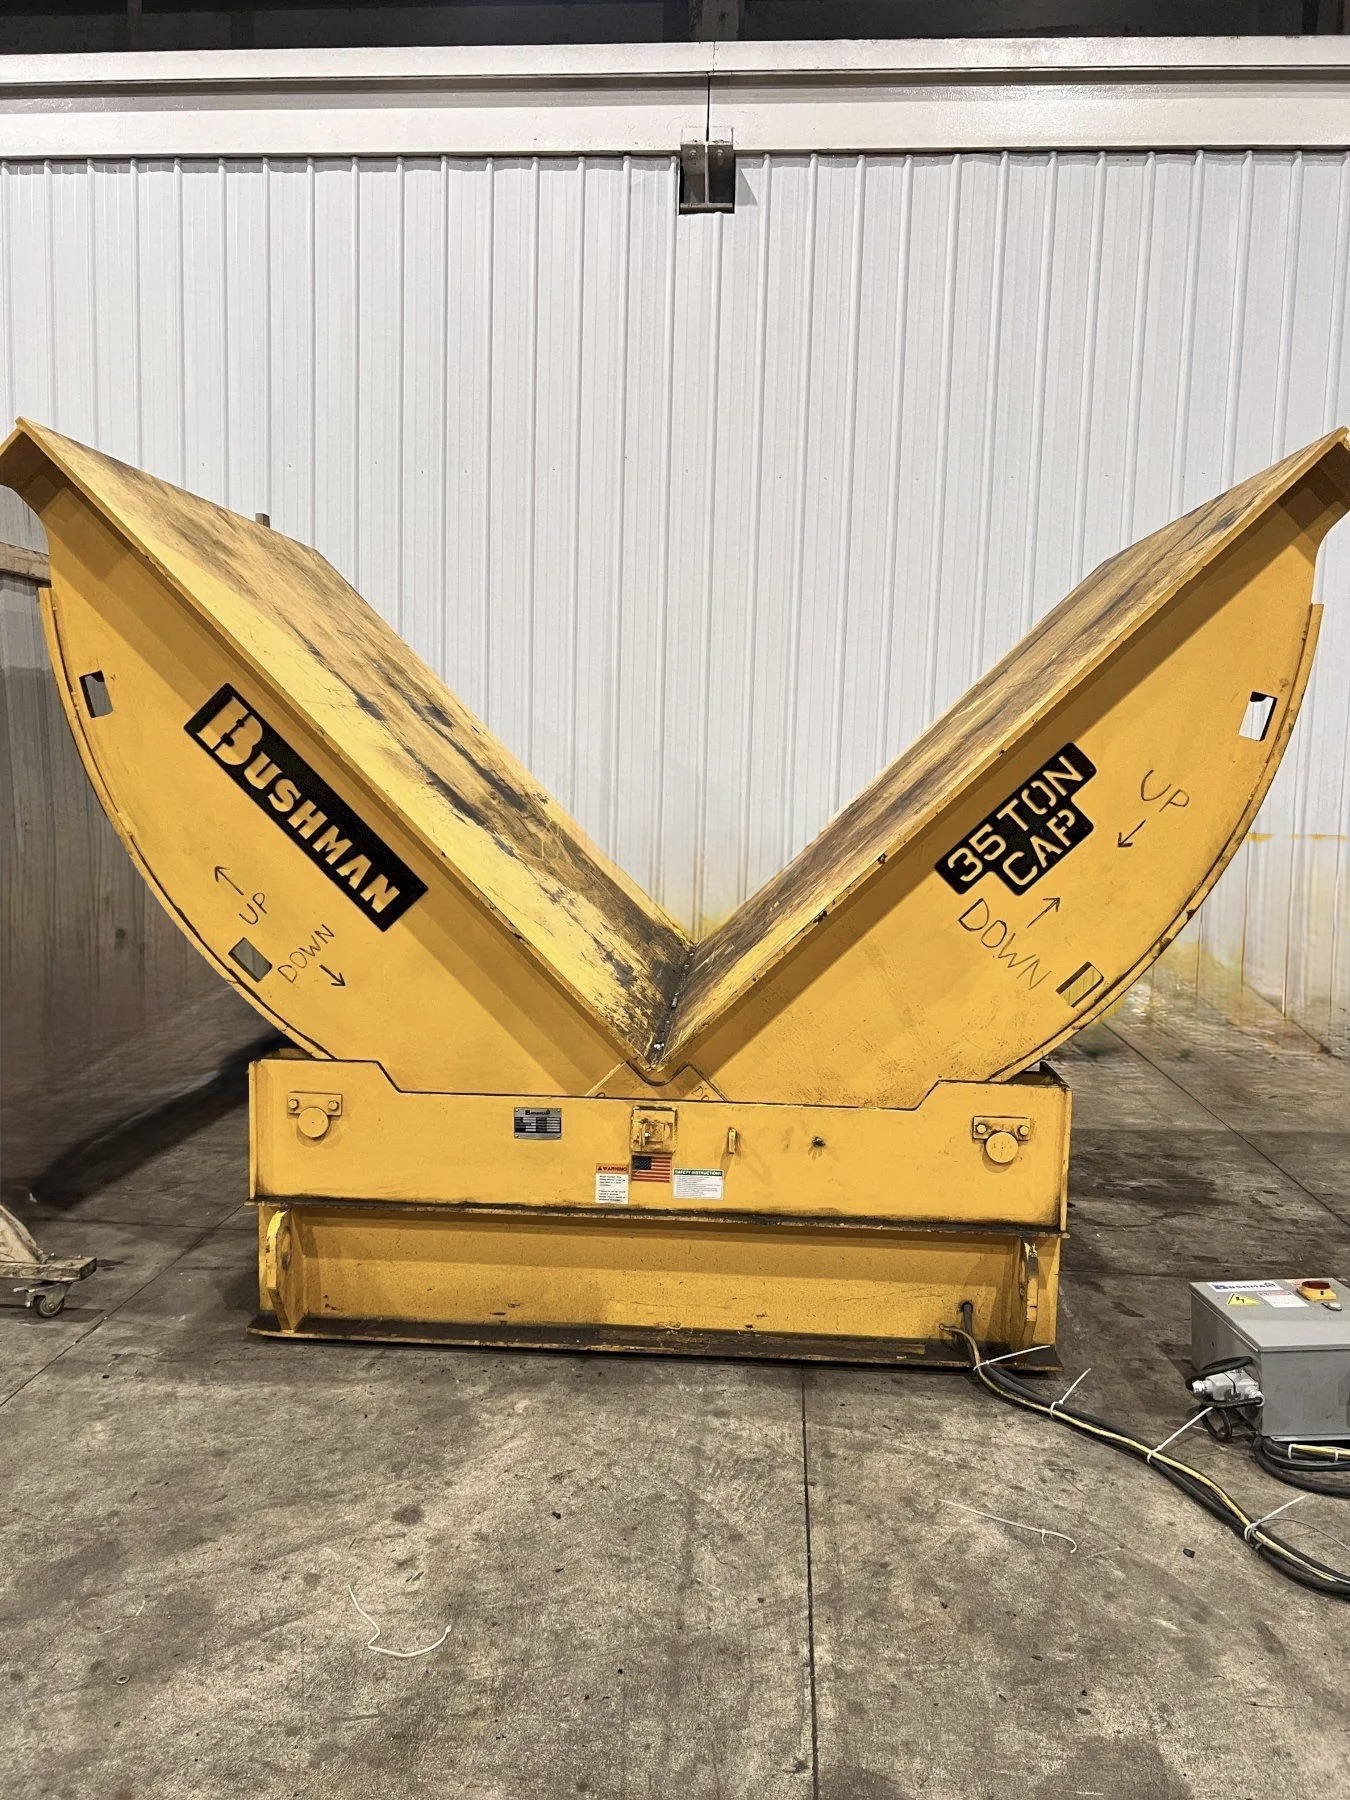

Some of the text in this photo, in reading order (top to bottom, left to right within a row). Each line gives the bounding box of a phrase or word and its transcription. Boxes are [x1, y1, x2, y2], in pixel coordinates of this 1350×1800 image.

[196, 697, 400, 913] BUSHMAN
[947, 755, 1084, 882] 35 TON
[1140, 769, 1190, 812] UP
[1002, 808, 1076, 886] CAP
[238, 892, 267, 925] UP
[957, 898, 1052, 990] DOWN
[277, 923, 335, 983] DOWN
